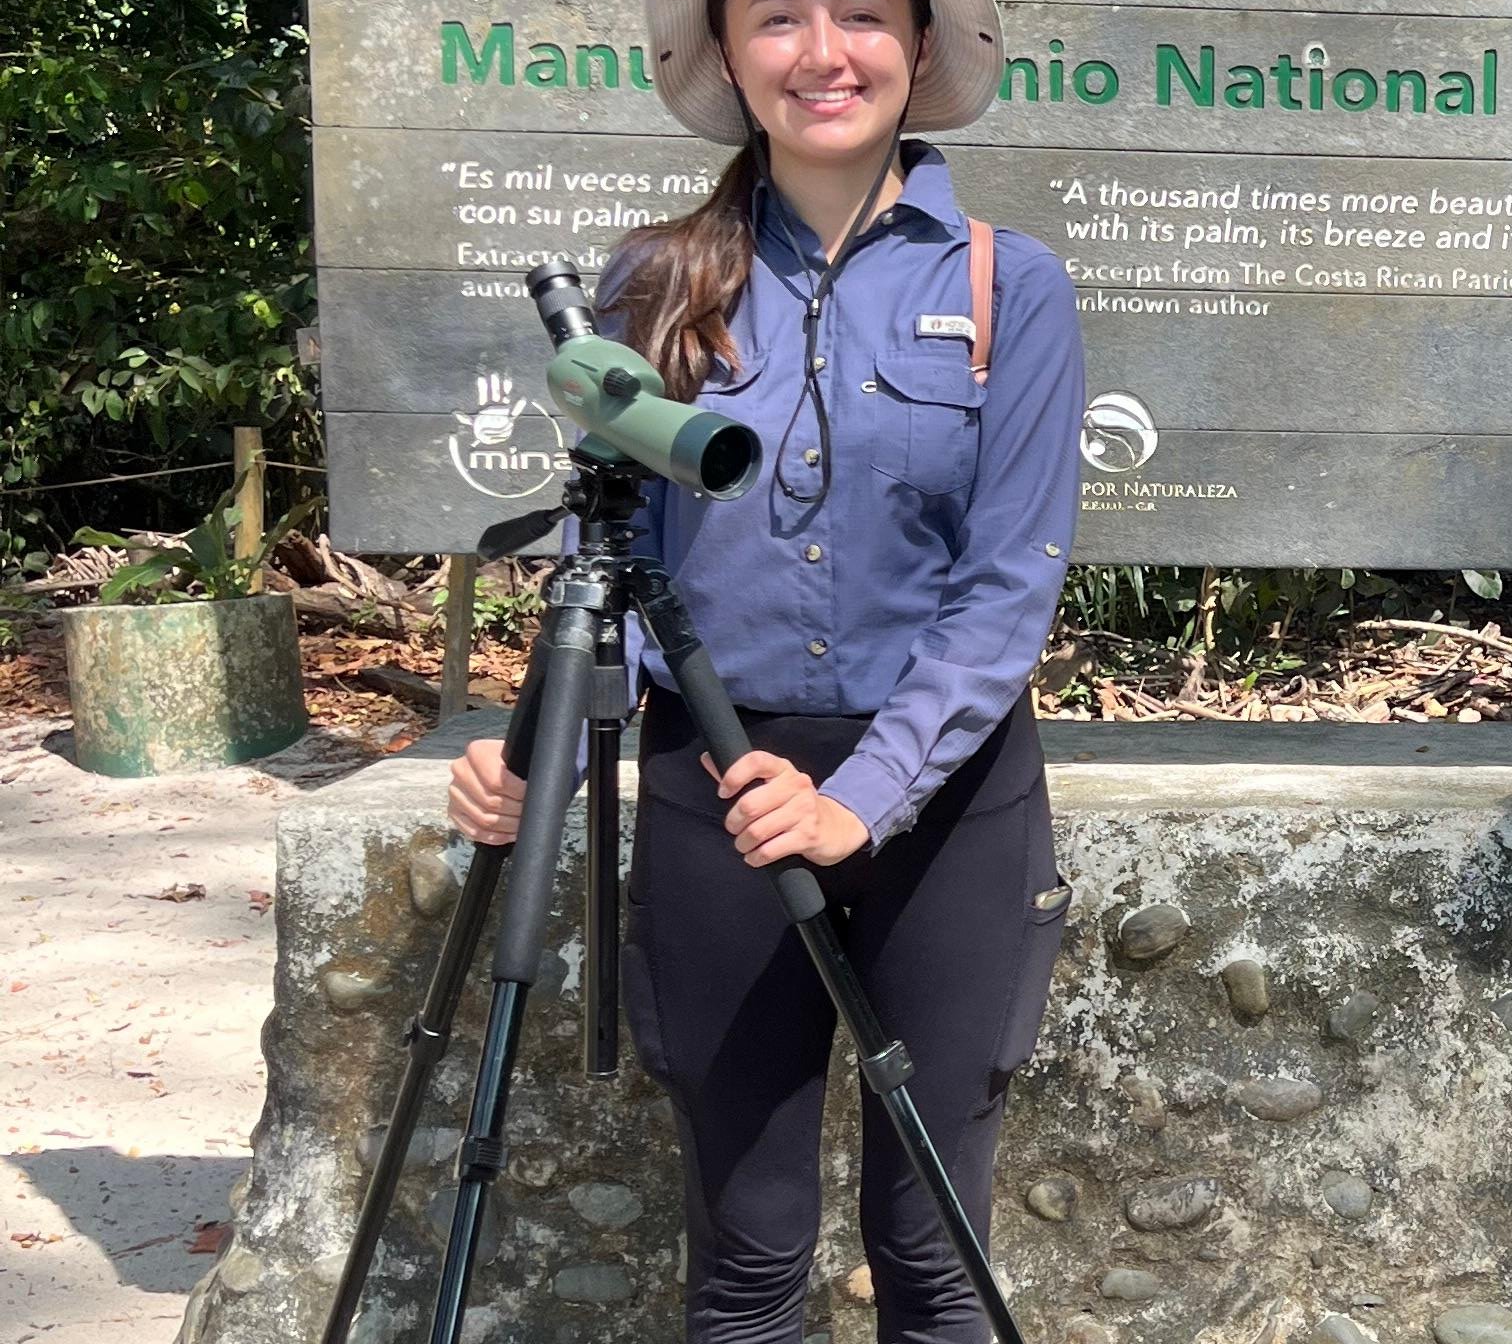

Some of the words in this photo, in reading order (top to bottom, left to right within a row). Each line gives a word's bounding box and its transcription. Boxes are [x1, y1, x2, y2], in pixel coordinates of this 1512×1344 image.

[1155, 42, 1497, 117] National
[441, 161, 495, 189] "Es
[504, 164, 553, 190] mil
[563, 172, 652, 193] veces
[1050, 179, 1088, 205] "A
[1099, 181, 1241, 210] thousand
[1250, 185, 1331, 212] times
[1341, 192, 1418, 215] more
[459, 204, 516, 225] con
[527, 207, 562, 226] su
[1065, 213, 1129, 241] with
[1140, 216, 1175, 243] its
[1184, 215, 1267, 249] palm,
[1280, 219, 1314, 247] its
[1324, 220, 1426, 249] breeze
[1435, 224, 1493, 250] and
[1065, 258, 1165, 287] Excerpt
[1172, 259, 1230, 285] from
[1239, 262, 1286, 286] The
[1295, 263, 1368, 288] Costa
[1377, 266, 1443, 290] Rican
[1189, 294, 1271, 316] author
[1082, 482, 1118, 496] POR
[1124, 482, 1238, 498] NATURALEZA
